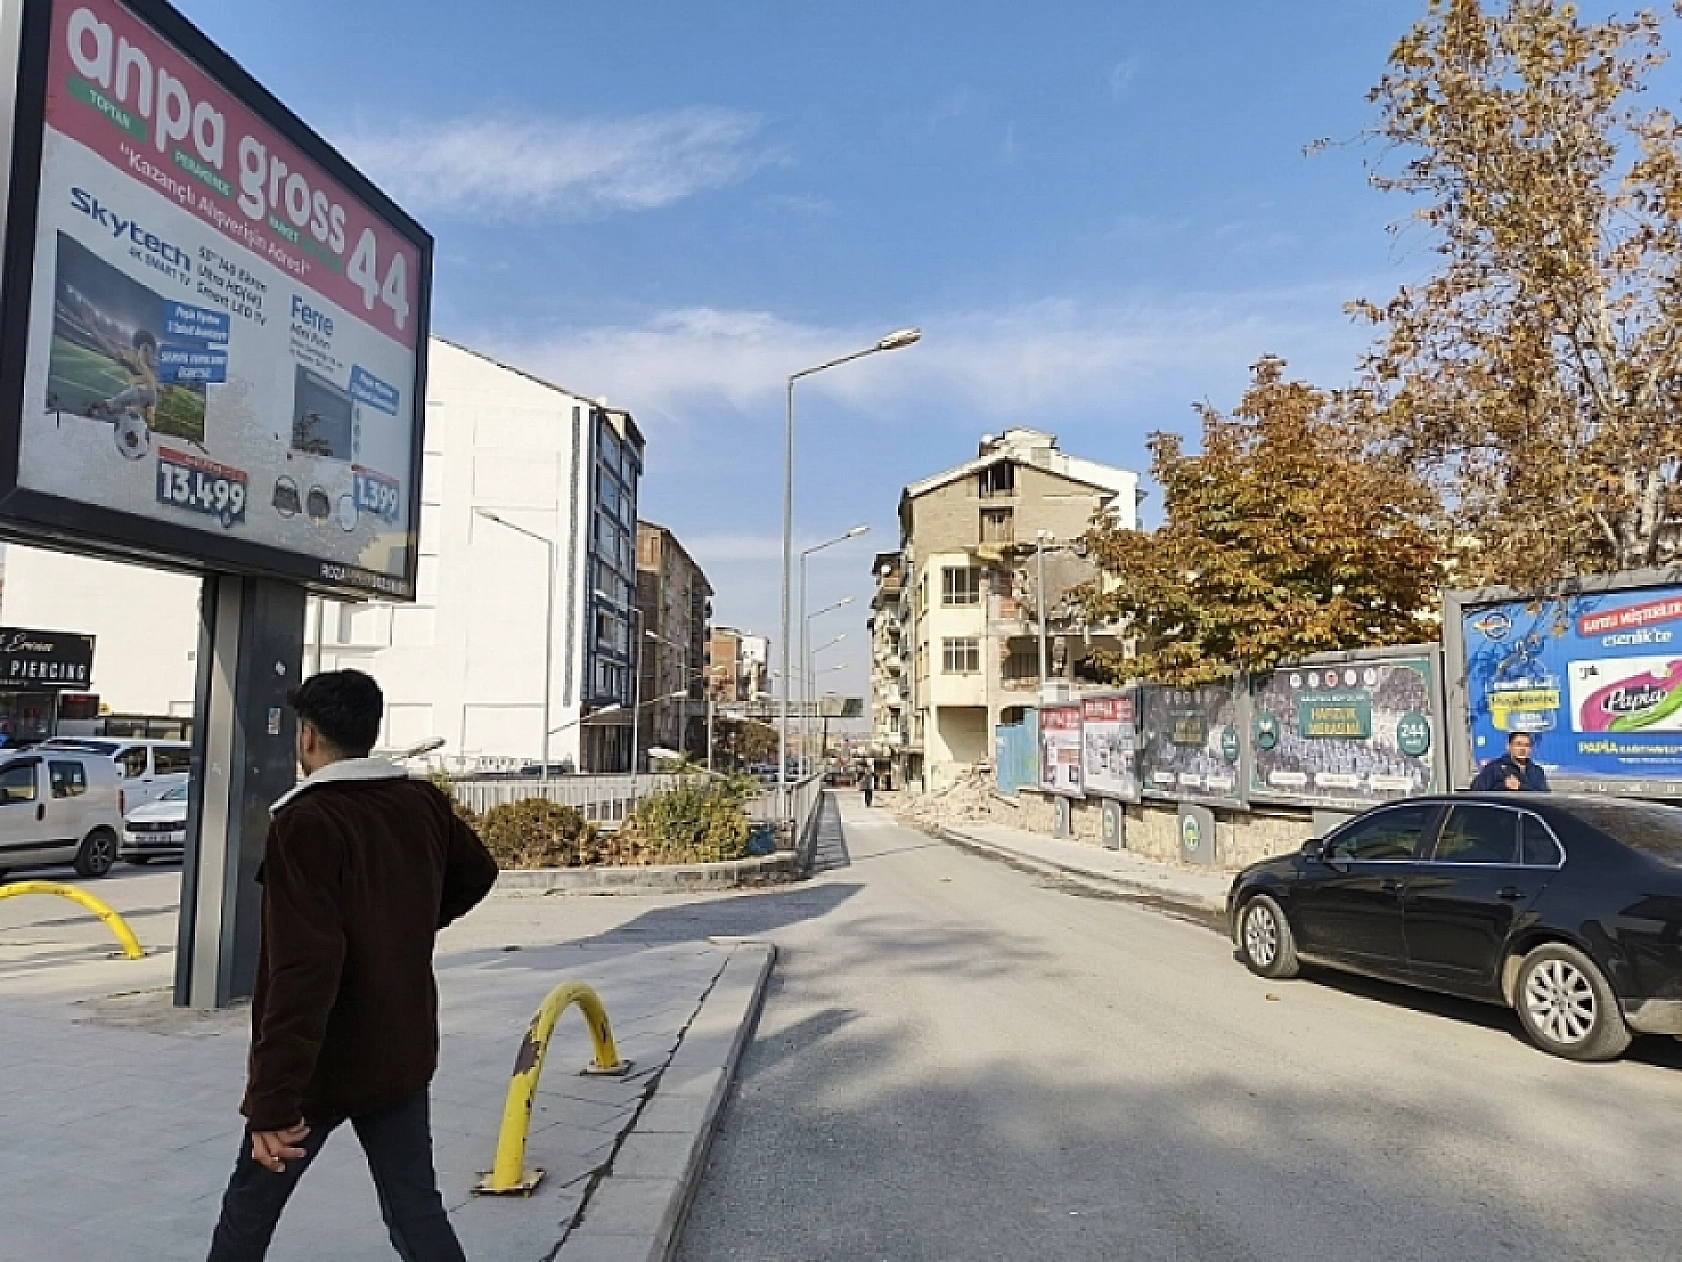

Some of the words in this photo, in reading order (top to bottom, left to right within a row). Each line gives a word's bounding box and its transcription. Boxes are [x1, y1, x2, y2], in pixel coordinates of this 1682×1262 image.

[89, 89, 131, 130] TOPTAN
[67, 7, 224, 170] anpa
[237, 135, 345, 255] gross
[347, 228, 410, 330] 44
[70, 187, 191, 271] Skytech
[291, 293, 334, 336] Ferre
[160, 462, 245, 515] 13.499
[10, 659, 86, 680] PIERCING
